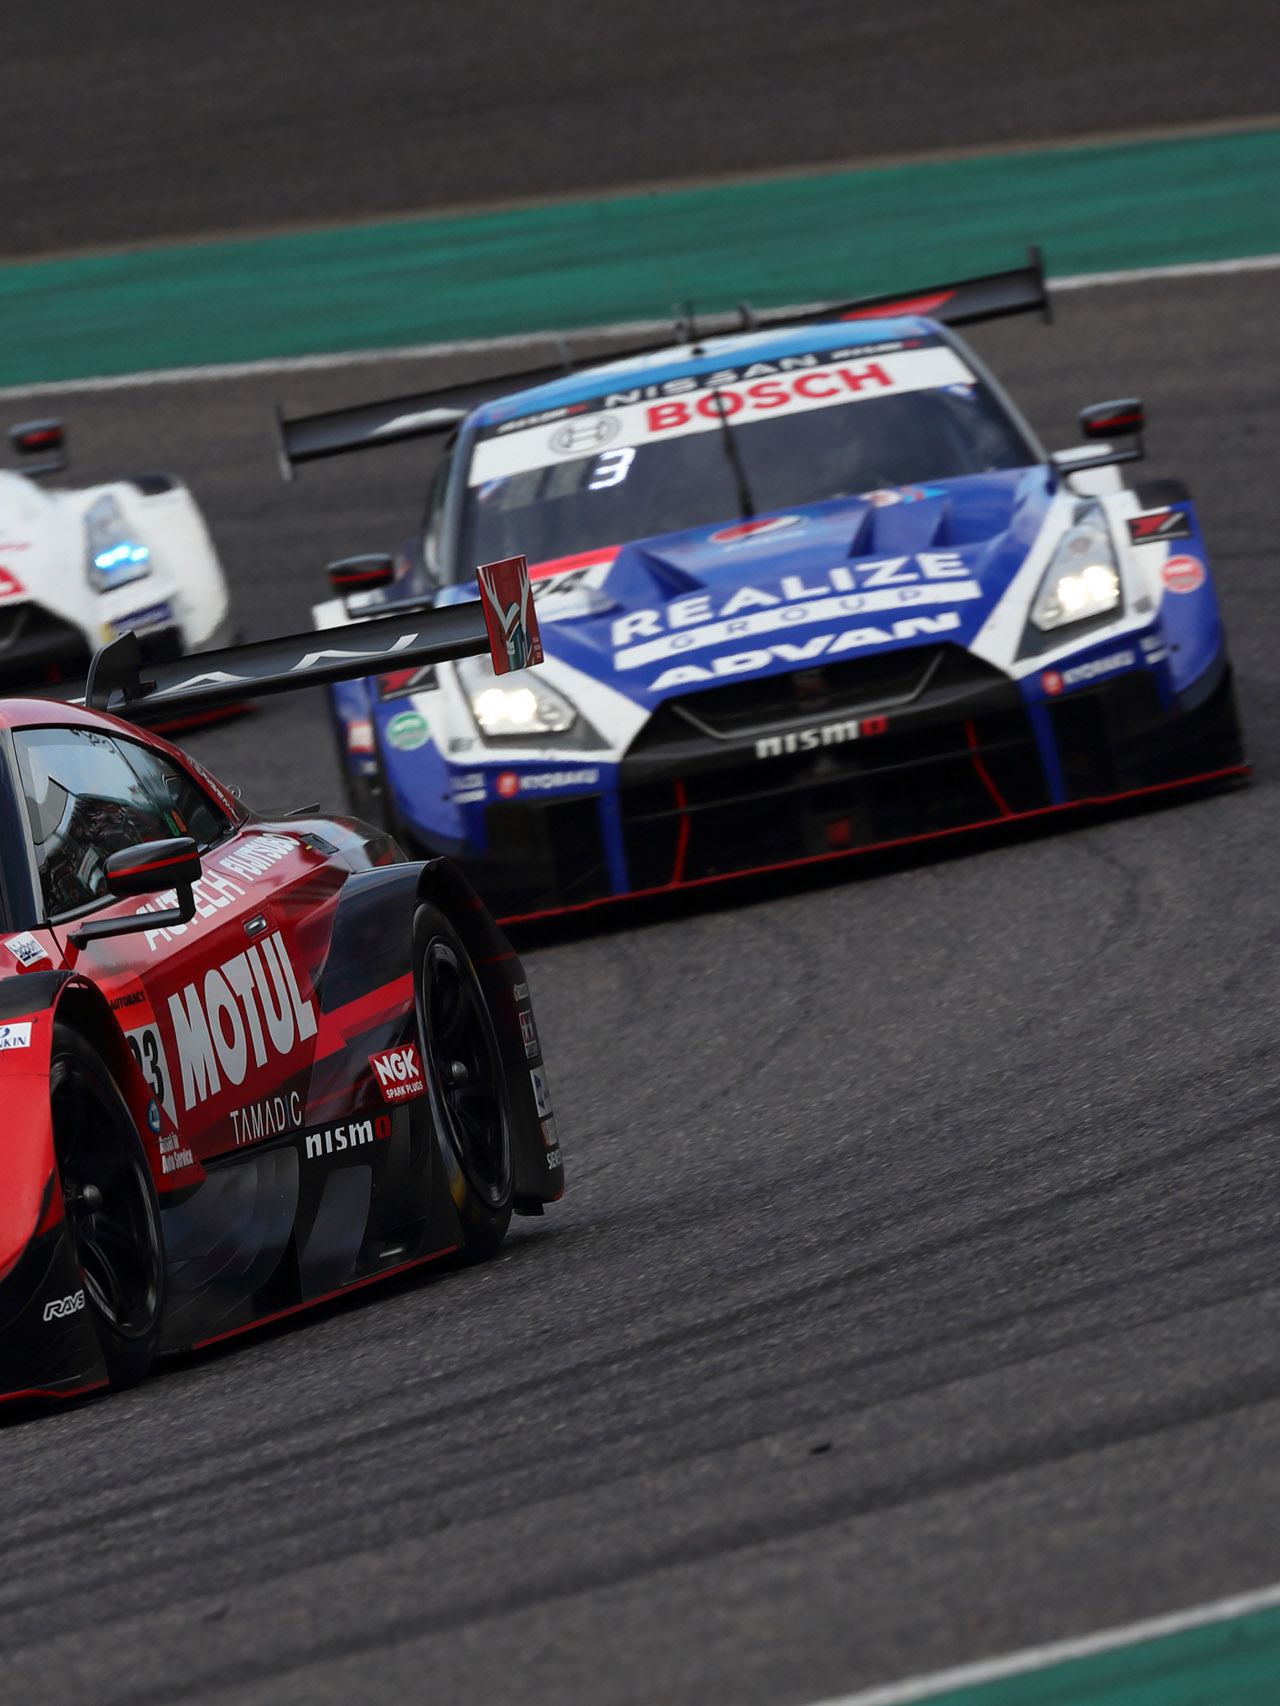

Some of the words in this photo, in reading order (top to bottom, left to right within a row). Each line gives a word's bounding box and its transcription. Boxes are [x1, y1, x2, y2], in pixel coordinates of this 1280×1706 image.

[604, 352, 819, 408] NISSAN
[646, 363, 894, 433] BOSCH
[588, 446, 636, 490] 3
[610, 552, 972, 647] REALIZE
[669, 586, 923, 652] GROUP
[646, 611, 962, 692] ADVAN
[754, 715, 888, 760] nismo
[219, 832, 301, 882] FUJITSUBO
[167, 930, 319, 1112] MOTUL
[373, 1047, 419, 1086] NGK
[385, 1085, 407, 1099] SPARK
[229, 1090, 303, 1145] TAMADIC
[305, 1115, 392, 1159] nismo
[43, 1289, 85, 1322] RAYS
